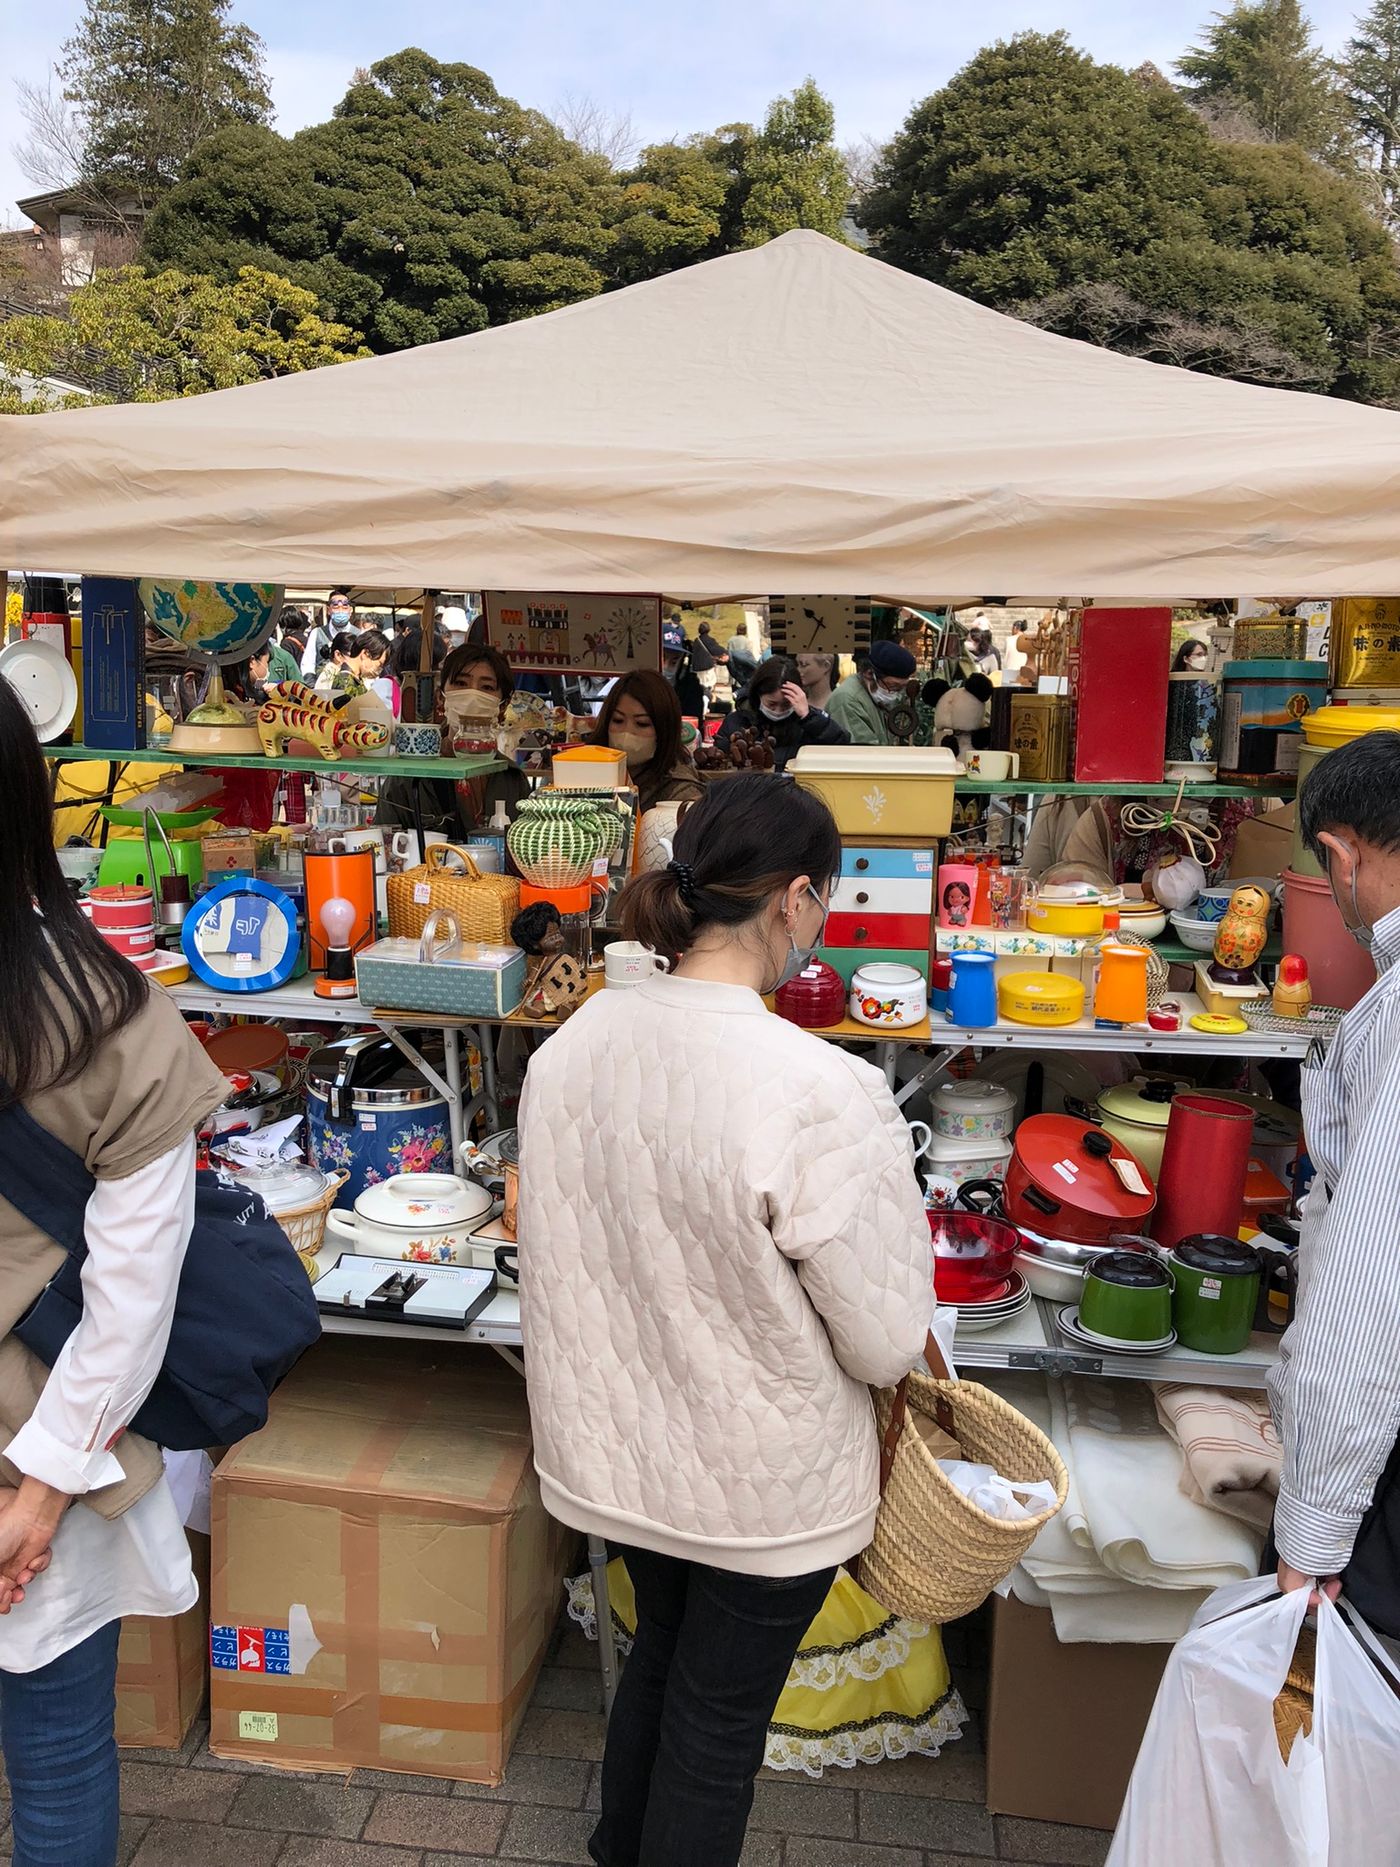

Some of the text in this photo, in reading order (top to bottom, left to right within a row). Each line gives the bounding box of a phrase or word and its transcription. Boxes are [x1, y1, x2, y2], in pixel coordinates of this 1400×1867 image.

[213, 1655, 237, 1666] ガラス
[266, 1662, 291, 1672] ガラス
